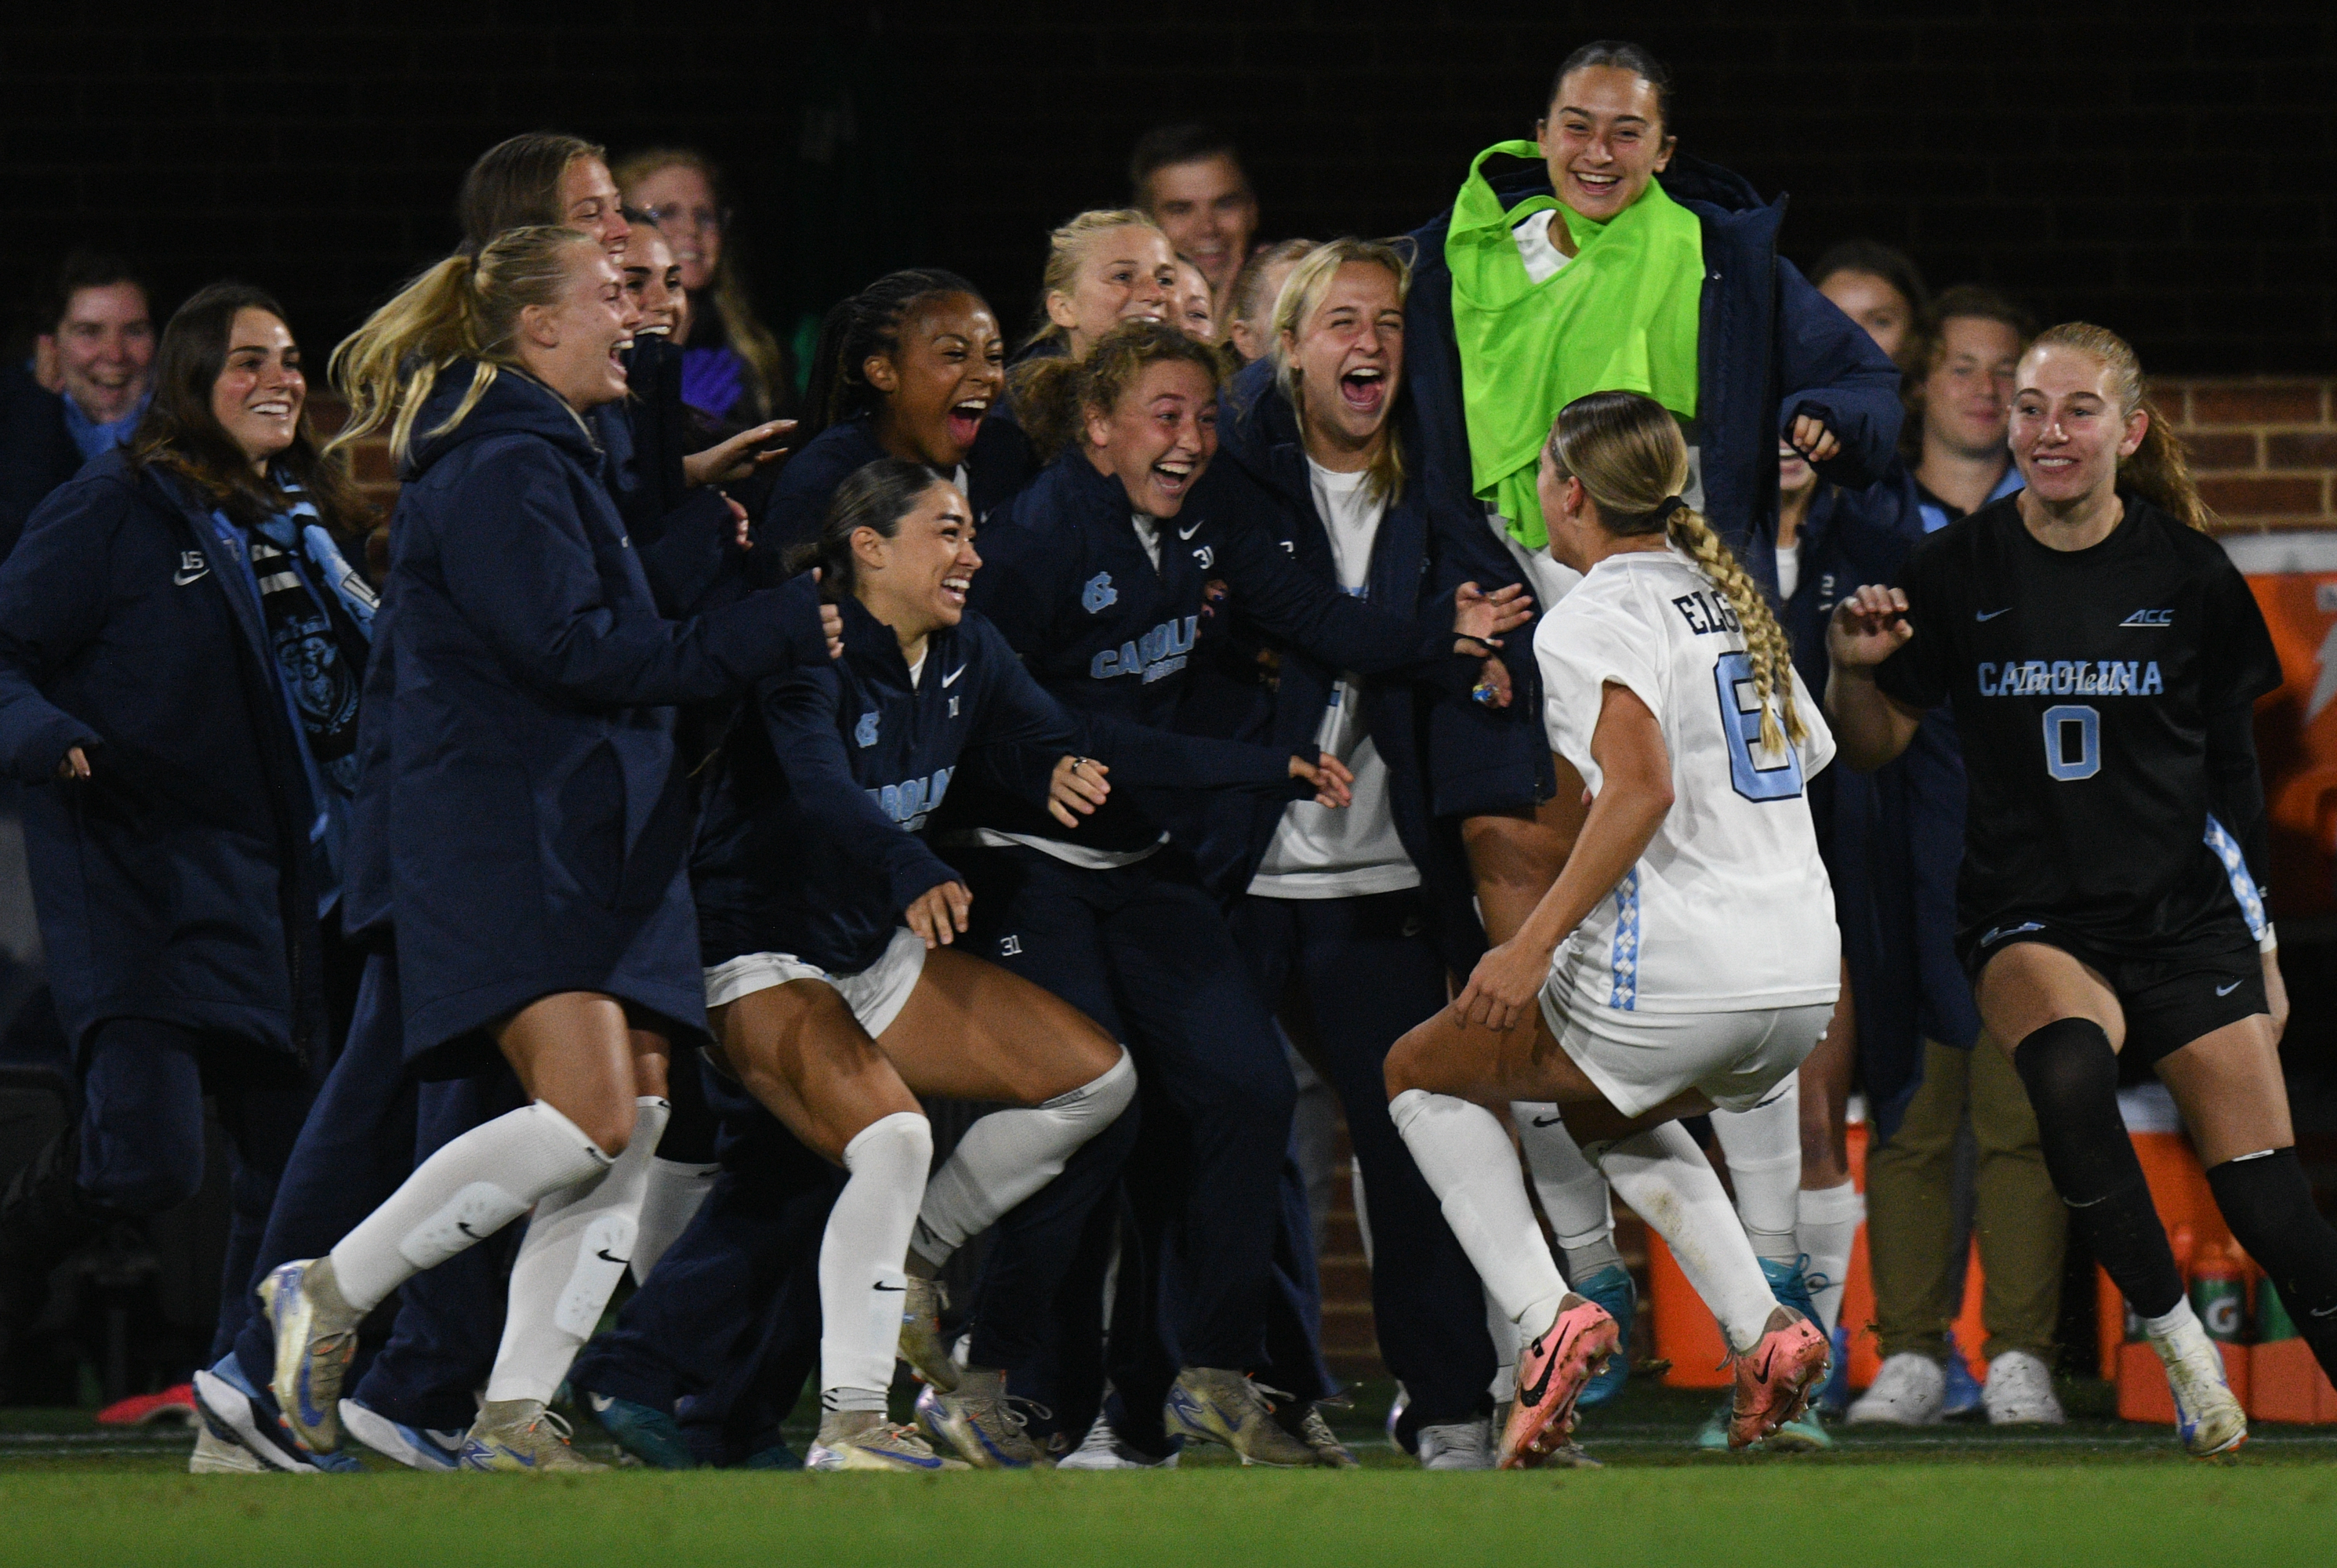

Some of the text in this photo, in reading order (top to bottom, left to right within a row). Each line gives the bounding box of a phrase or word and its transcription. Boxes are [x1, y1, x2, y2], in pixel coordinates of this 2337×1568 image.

[2122, 608, 2175, 623] ACC
[1977, 660, 2165, 696] CAROLINA
[2010, 662, 2132, 692] Tar Heels
[2042, 705, 2102, 782] 0
[1000, 935, 1023, 956] 31
[2206, 1296, 2238, 1334] G
